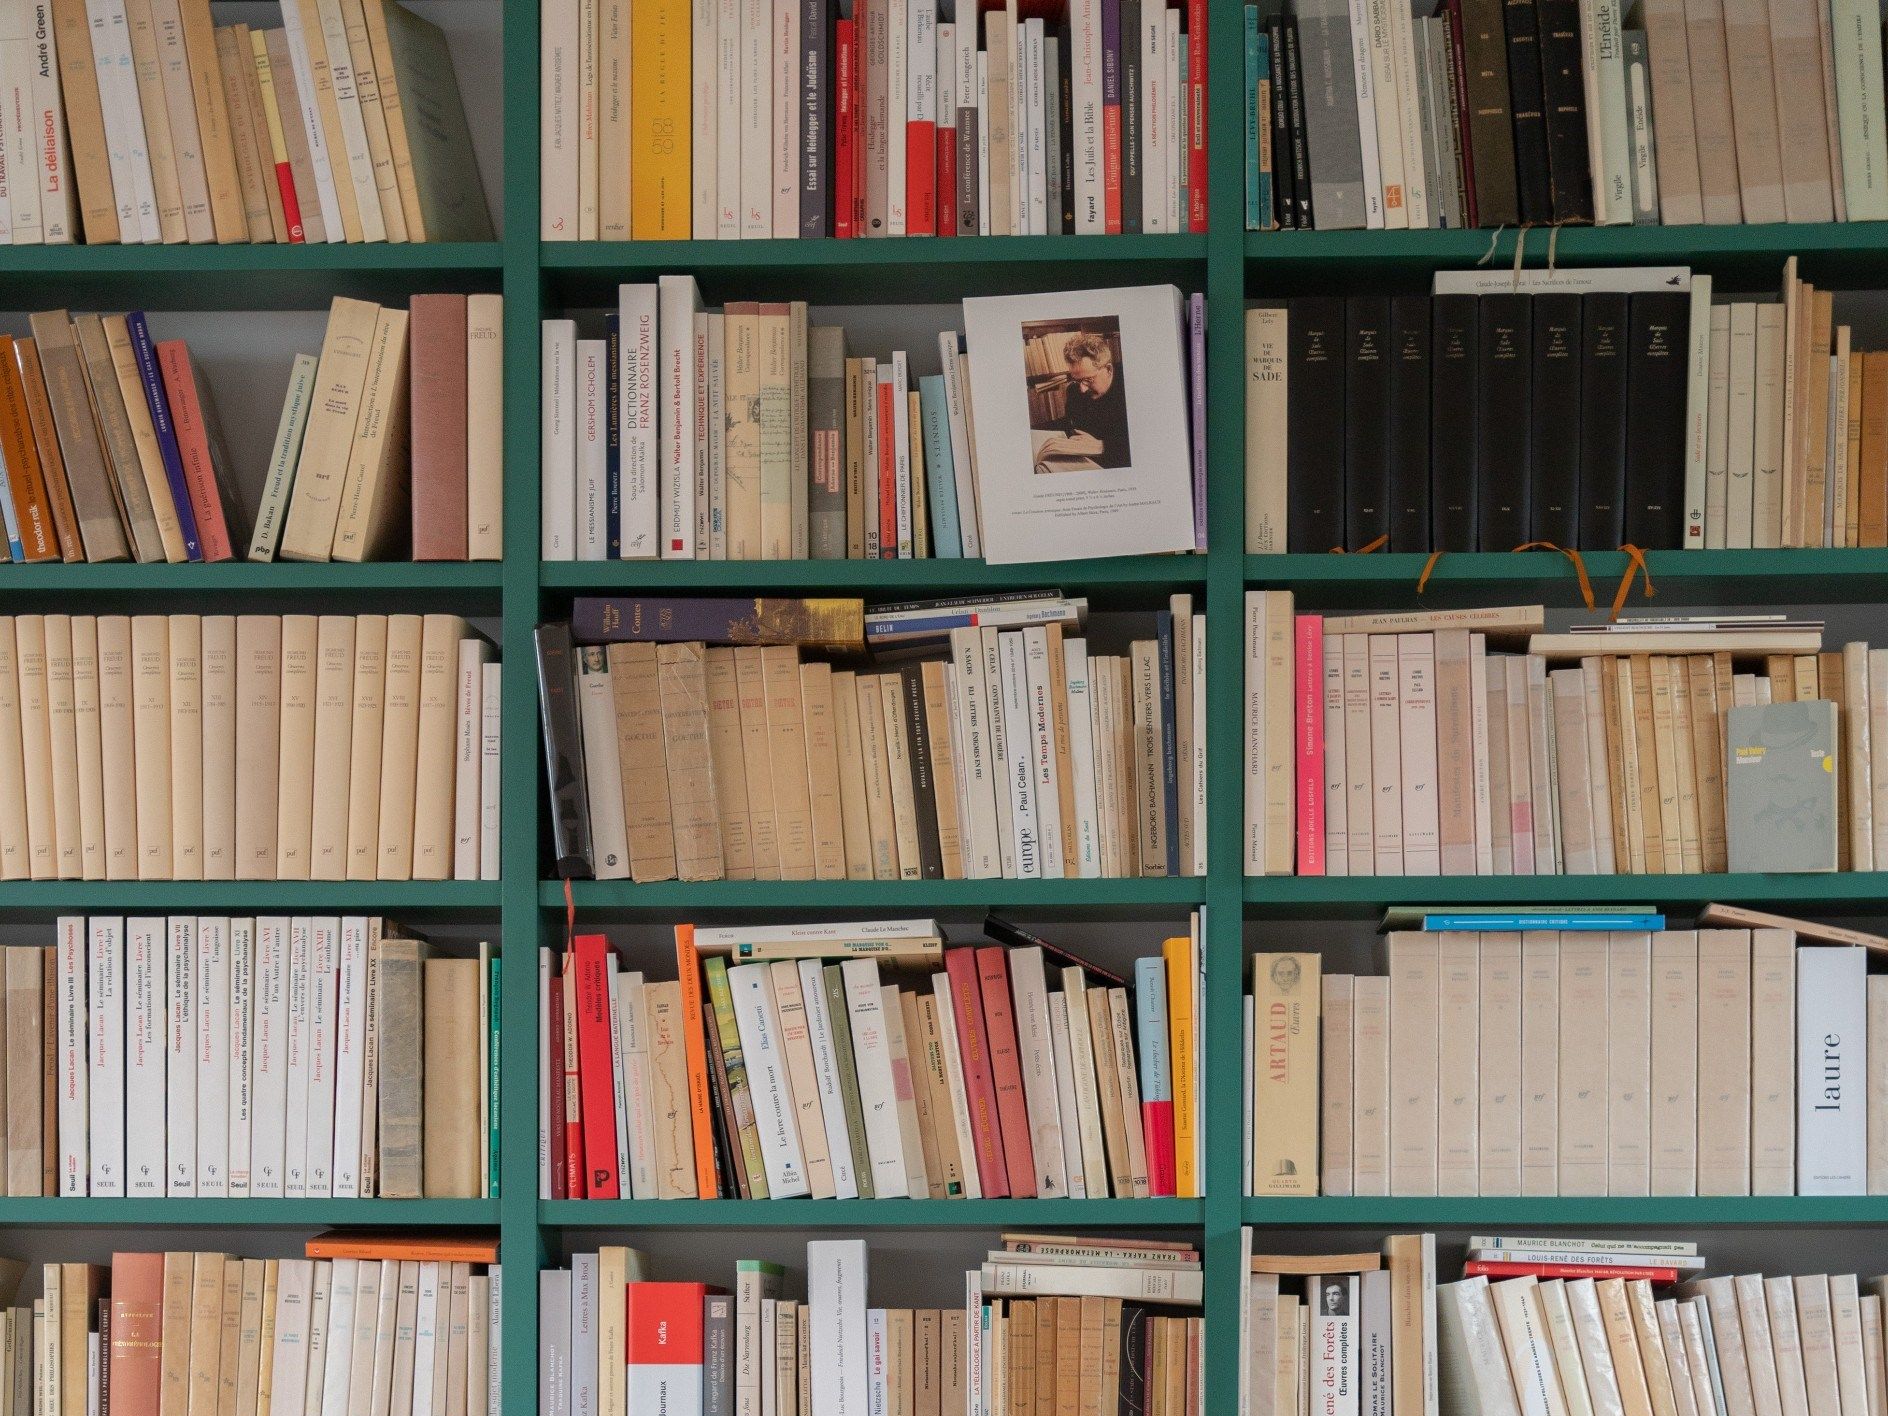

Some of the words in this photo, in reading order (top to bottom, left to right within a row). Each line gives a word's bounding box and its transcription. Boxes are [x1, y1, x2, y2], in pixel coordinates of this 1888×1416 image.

[34, 4, 47, 39] Green
[37, 43, 50, 77] André
[808, 50, 817, 89] Judaïsme
[963, 46, 971, 82] Longerich
[808, 92, 817, 100] le
[1107, 75, 1115, 98] DANIEL
[808, 101, 817, 110] et
[42, 109, 57, 171] déliaison
[808, 112, 819, 152] Heidegger
[963, 110, 971, 142] Wannsee
[963, 143, 971, 154] de
[46, 174, 59, 192] La
[808, 171, 817, 190] Essai
[963, 155, 971, 193] conférence
[964, 194, 971, 203] La
[1087, 196, 1097, 223] fayard
[640, 315, 649, 389] ROSENZWEIG
[696, 334, 704, 383] EXPÉRIENCE
[294, 374, 307, 392] juive
[588, 355, 596, 396] SCHOLEM
[627, 347, 637, 429] DICTIONNAIRE
[698, 384, 704, 395] ET
[1253, 371, 1282, 381] SADE
[287, 394, 303, 426] mystique
[588, 399, 596, 441] GERSHOM
[640, 392, 649, 429] FRANZ
[279, 428, 293, 459] tradition
[189, 447, 202, 473] infinie
[194, 475, 212, 508] guérison
[270, 477, 282, 498] Freud
[28, 504, 40, 520] reik
[201, 509, 212, 521] La
[263, 506, 275, 529] Bakan
[31, 521, 46, 553] theodor
[261, 531, 270, 539] D.
[632, 603, 640, 634] Contes
[1142, 656, 1151, 670] LAC
[1143, 672, 1151, 681] LE
[1143, 683, 1152, 700] VERS
[1034, 685, 1046, 731] Modernes
[1144, 702, 1153, 735] SENTIERS
[1305, 693, 1313, 723] Breton
[1038, 734, 1050, 765] Temps
[1145, 737, 1154, 757] TROIS
[1305, 725, 1314, 755] Simone
[1017, 761, 1027, 789] Celan
[1041, 768, 1050, 784] Les
[1146, 763, 1156, 807] BACHMANN
[1019, 792, 1028, 811] Paul
[1148, 809, 1158, 849] INGEBORG
[1021, 828, 1037, 873] europe
[67, 924, 75, 960] Psychoses
[593, 960, 604, 991] critiques
[594, 993, 603, 1022] Modèles
[754, 1005, 767, 1030] Canetti
[1290, 1001, 1301, 1035] Œuvres
[758, 1032, 770, 1050] Elias
[1270, 1002, 1287, 1083] ARTAUD
[68, 1072, 76, 1100] Jacques
[764, 1065, 776, 1084] mort
[1815, 1033, 1841, 1111] laure
[769, 1094, 782, 1118] contre
[774, 1119, 785, 1135] livre
[777, 1136, 787, 1147] Le
[1528, 1253, 1568, 1262] LOUIS-RENÉ
[1587, 1255, 1613, 1263] FORÊTS
[658, 1321, 667, 1344] Kafka
[1323, 1321, 1335, 1360] Forêts
[1339, 1322, 1350, 1364] complètes
[1323, 1366, 1335, 1387] des
[1339, 1365, 1348, 1396] Œuvres
[658, 1380, 666, 1416] Journaux
[874, 1381, 882, 1414] Nietzsche
